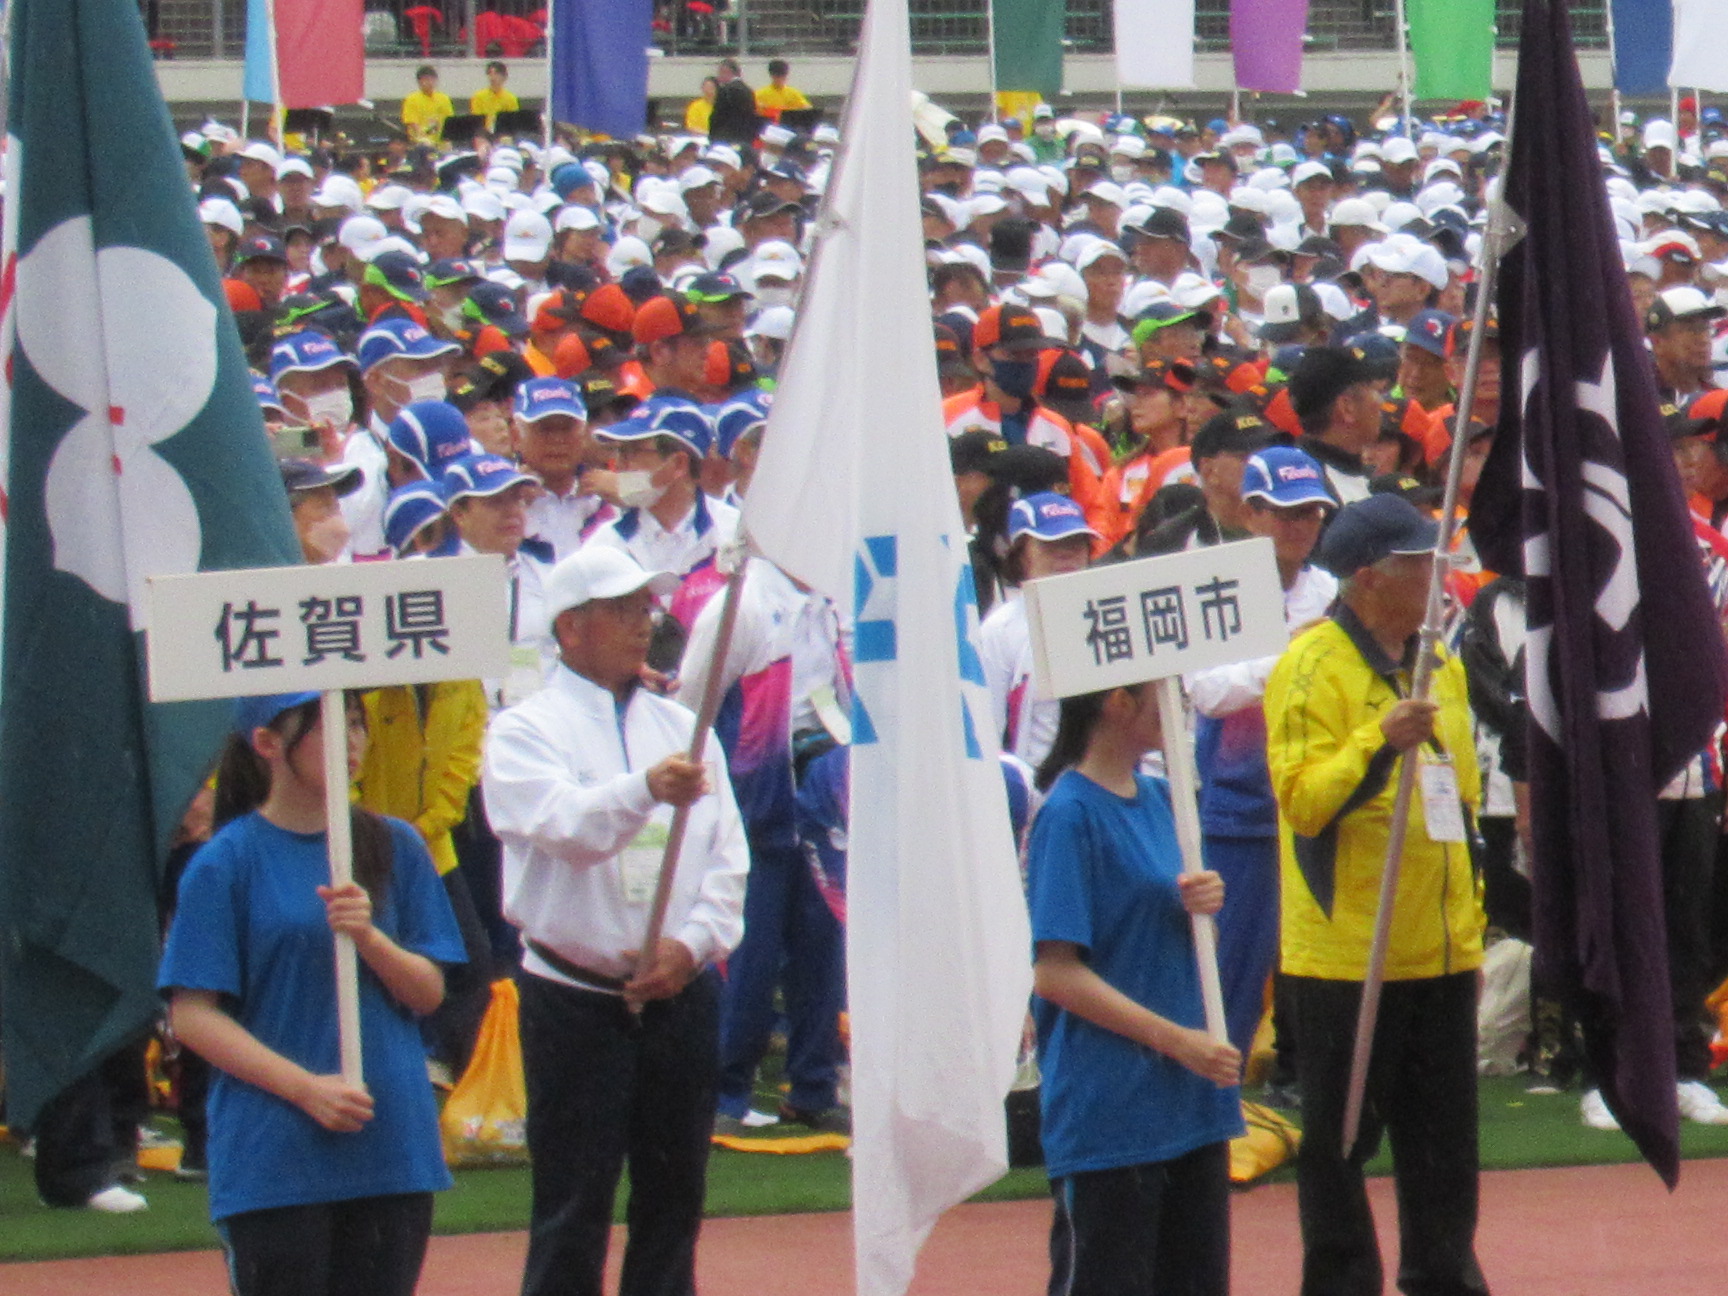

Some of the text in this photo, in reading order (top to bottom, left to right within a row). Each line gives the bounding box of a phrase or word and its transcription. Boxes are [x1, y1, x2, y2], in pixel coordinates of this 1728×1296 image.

[214, 589, 450, 673] 佐賀県
[1083, 576, 1242, 666] 福岡市
